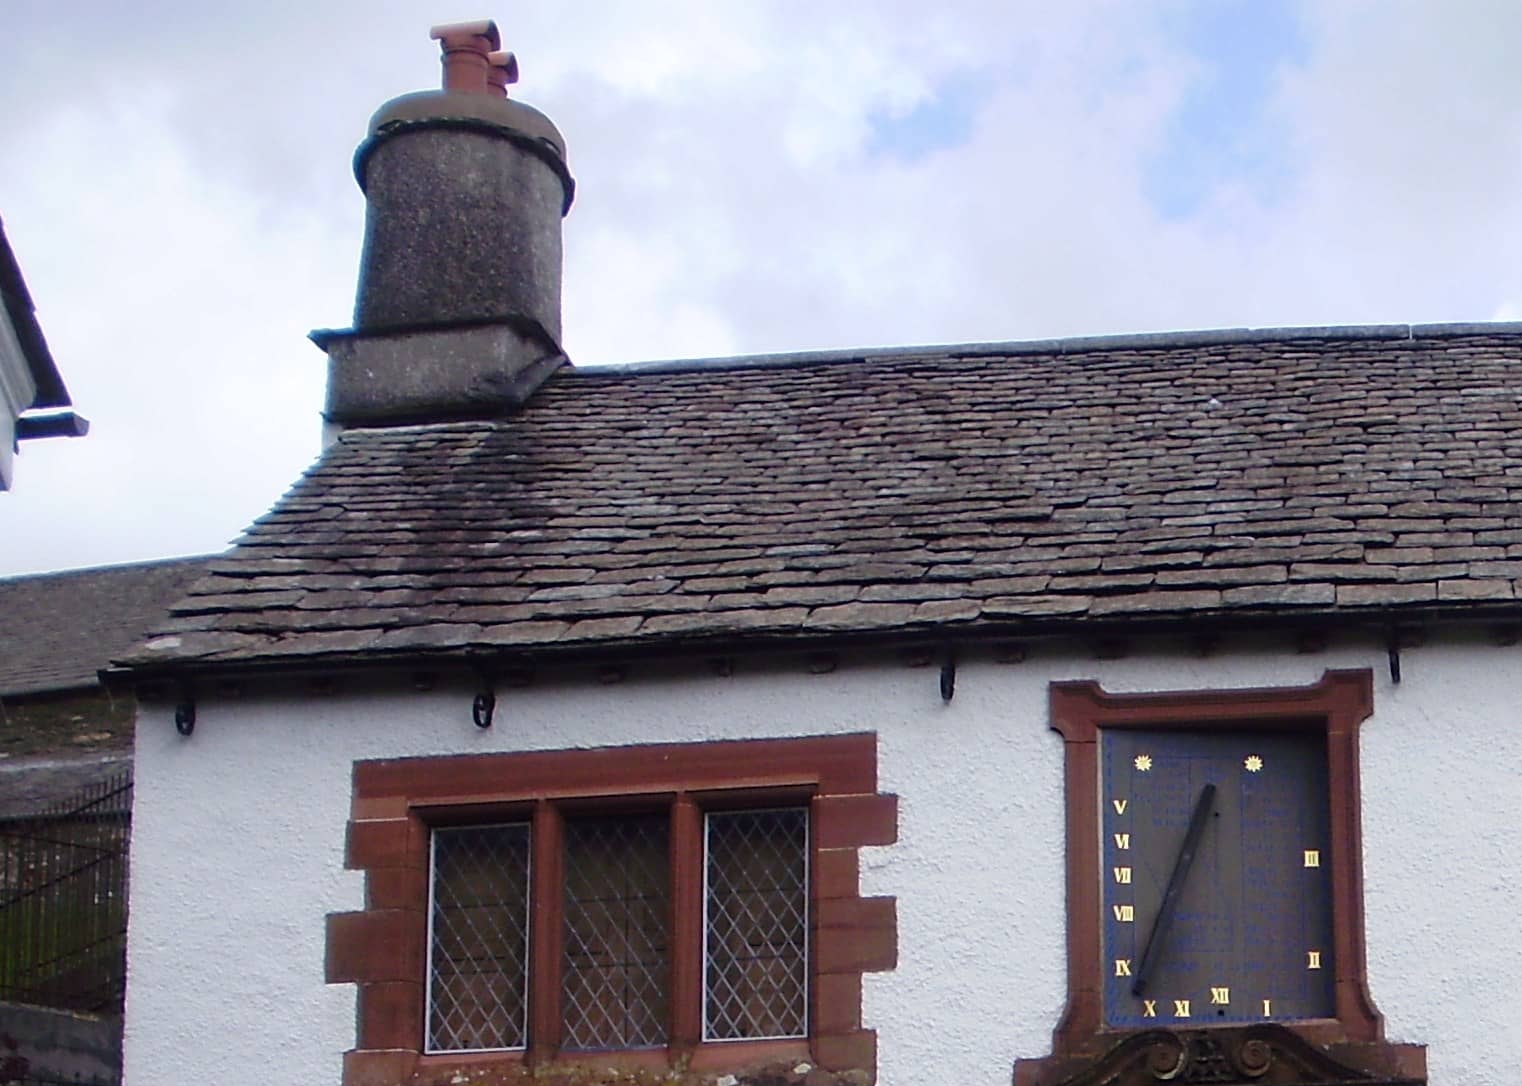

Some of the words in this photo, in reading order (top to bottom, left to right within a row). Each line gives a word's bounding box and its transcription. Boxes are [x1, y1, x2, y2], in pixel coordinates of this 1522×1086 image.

[1114, 800, 1127, 814] V
[1114, 834, 1129, 850] VI
[1304, 850, 1320, 867] III
[1114, 868, 1131, 884] VII
[1114, 906, 1134, 922] VIII
[1115, 960, 1132, 976] IX
[1308, 952, 1321, 968] II
[1211, 987, 1230, 1004] XII
[1144, 1000, 1157, 1017] X
[1174, 1000, 1190, 1017] XI
[1263, 1000, 1271, 1016] I
